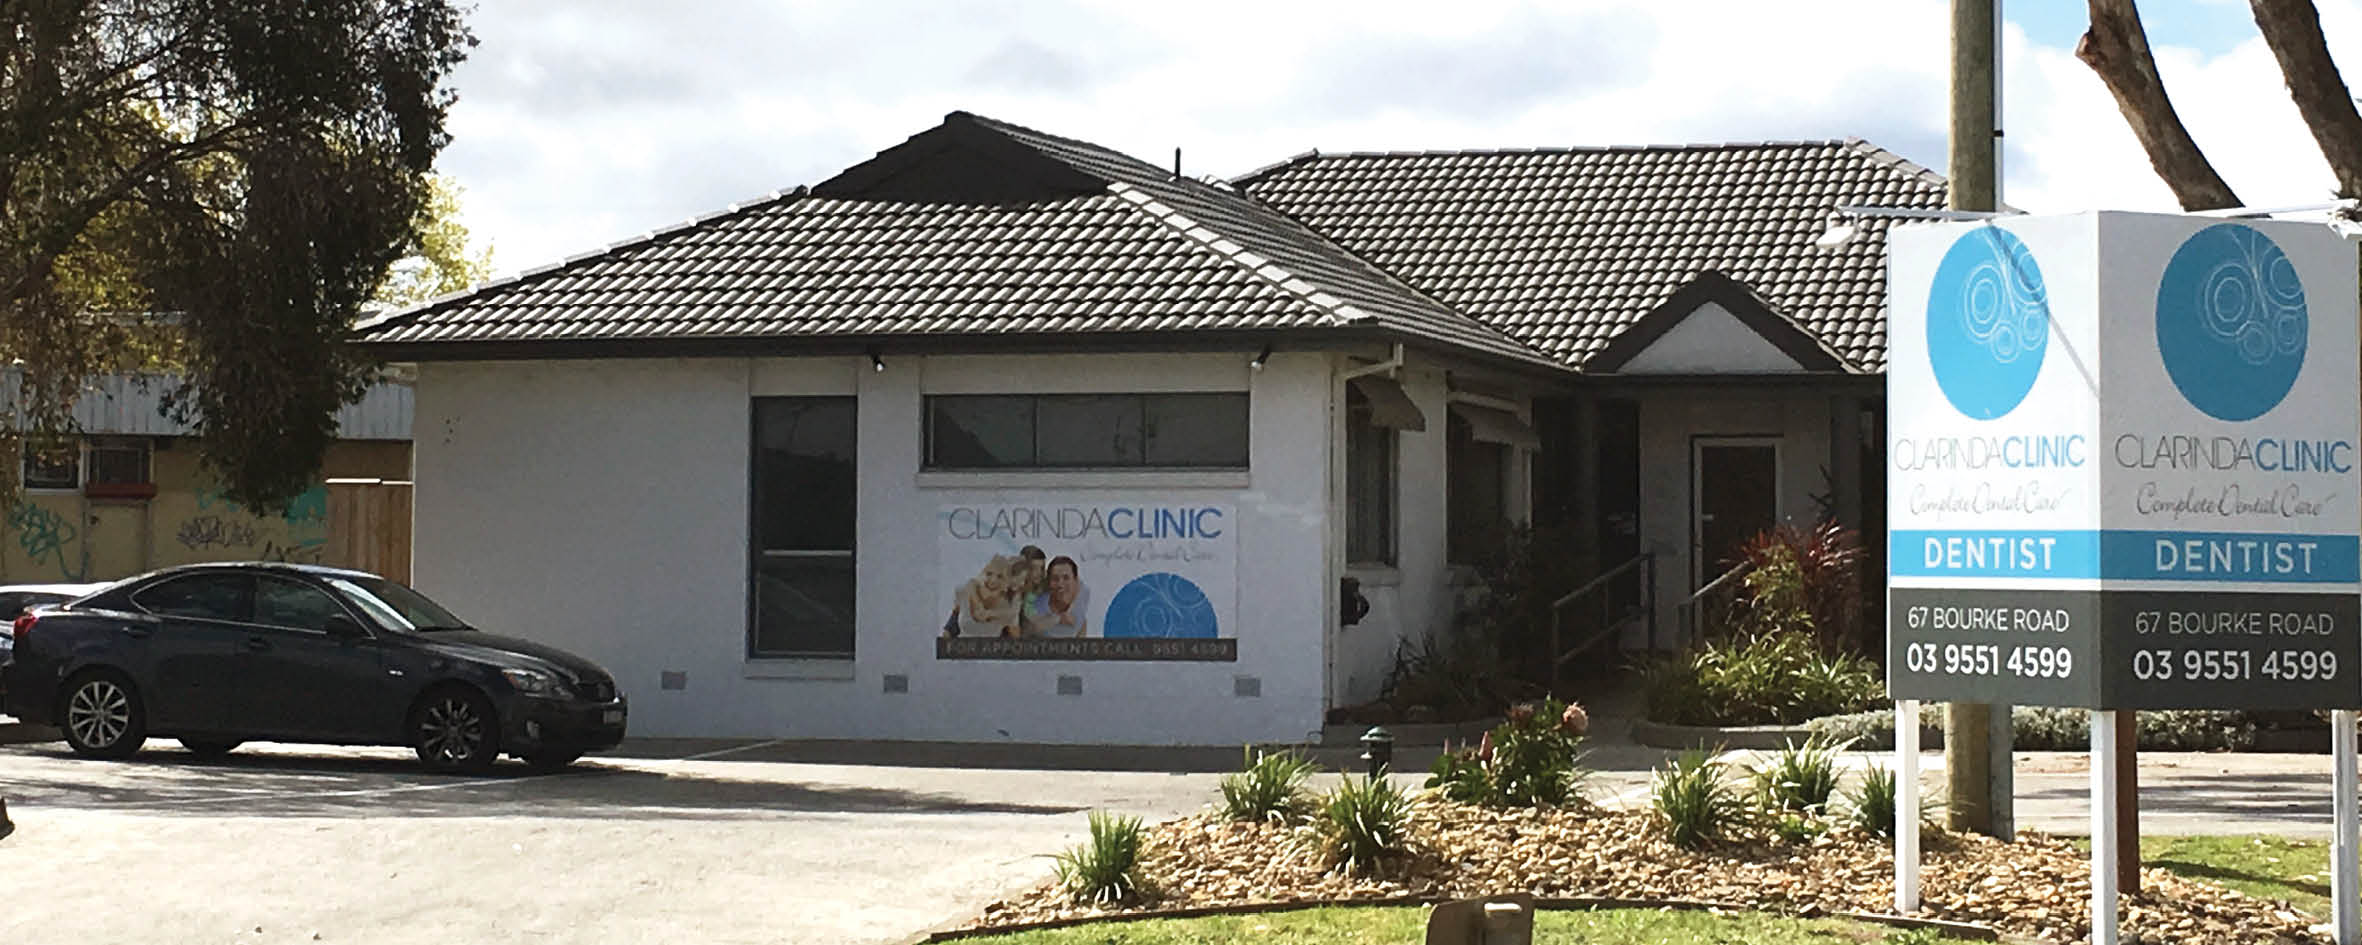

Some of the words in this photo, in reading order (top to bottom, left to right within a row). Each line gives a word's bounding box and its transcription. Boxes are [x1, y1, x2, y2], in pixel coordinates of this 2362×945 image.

[2136, 481, 2215, 520] Complete
[2217, 483, 2279, 517] Dental
[1924, 537, 2057, 570] DENTIST
[2155, 539, 2318, 574] DENTIST
[1907, 606, 1930, 629] 67
[1932, 607, 2009, 632] BOURKE
[2013, 609, 2070, 633] ROAD
[2135, 613, 2163, 635] 67
[2168, 612, 2263, 636] BOURKE
[2269, 612, 2334, 637] ROAD
[1906, 643, 1938, 673] 03
[1943, 645, 1999, 676] 9551
[2006, 647, 2073, 679] 4599
[2133, 651, 2173, 680] 03
[2184, 651, 2252, 681] 9551
[2261, 651, 2338, 680] 4599
